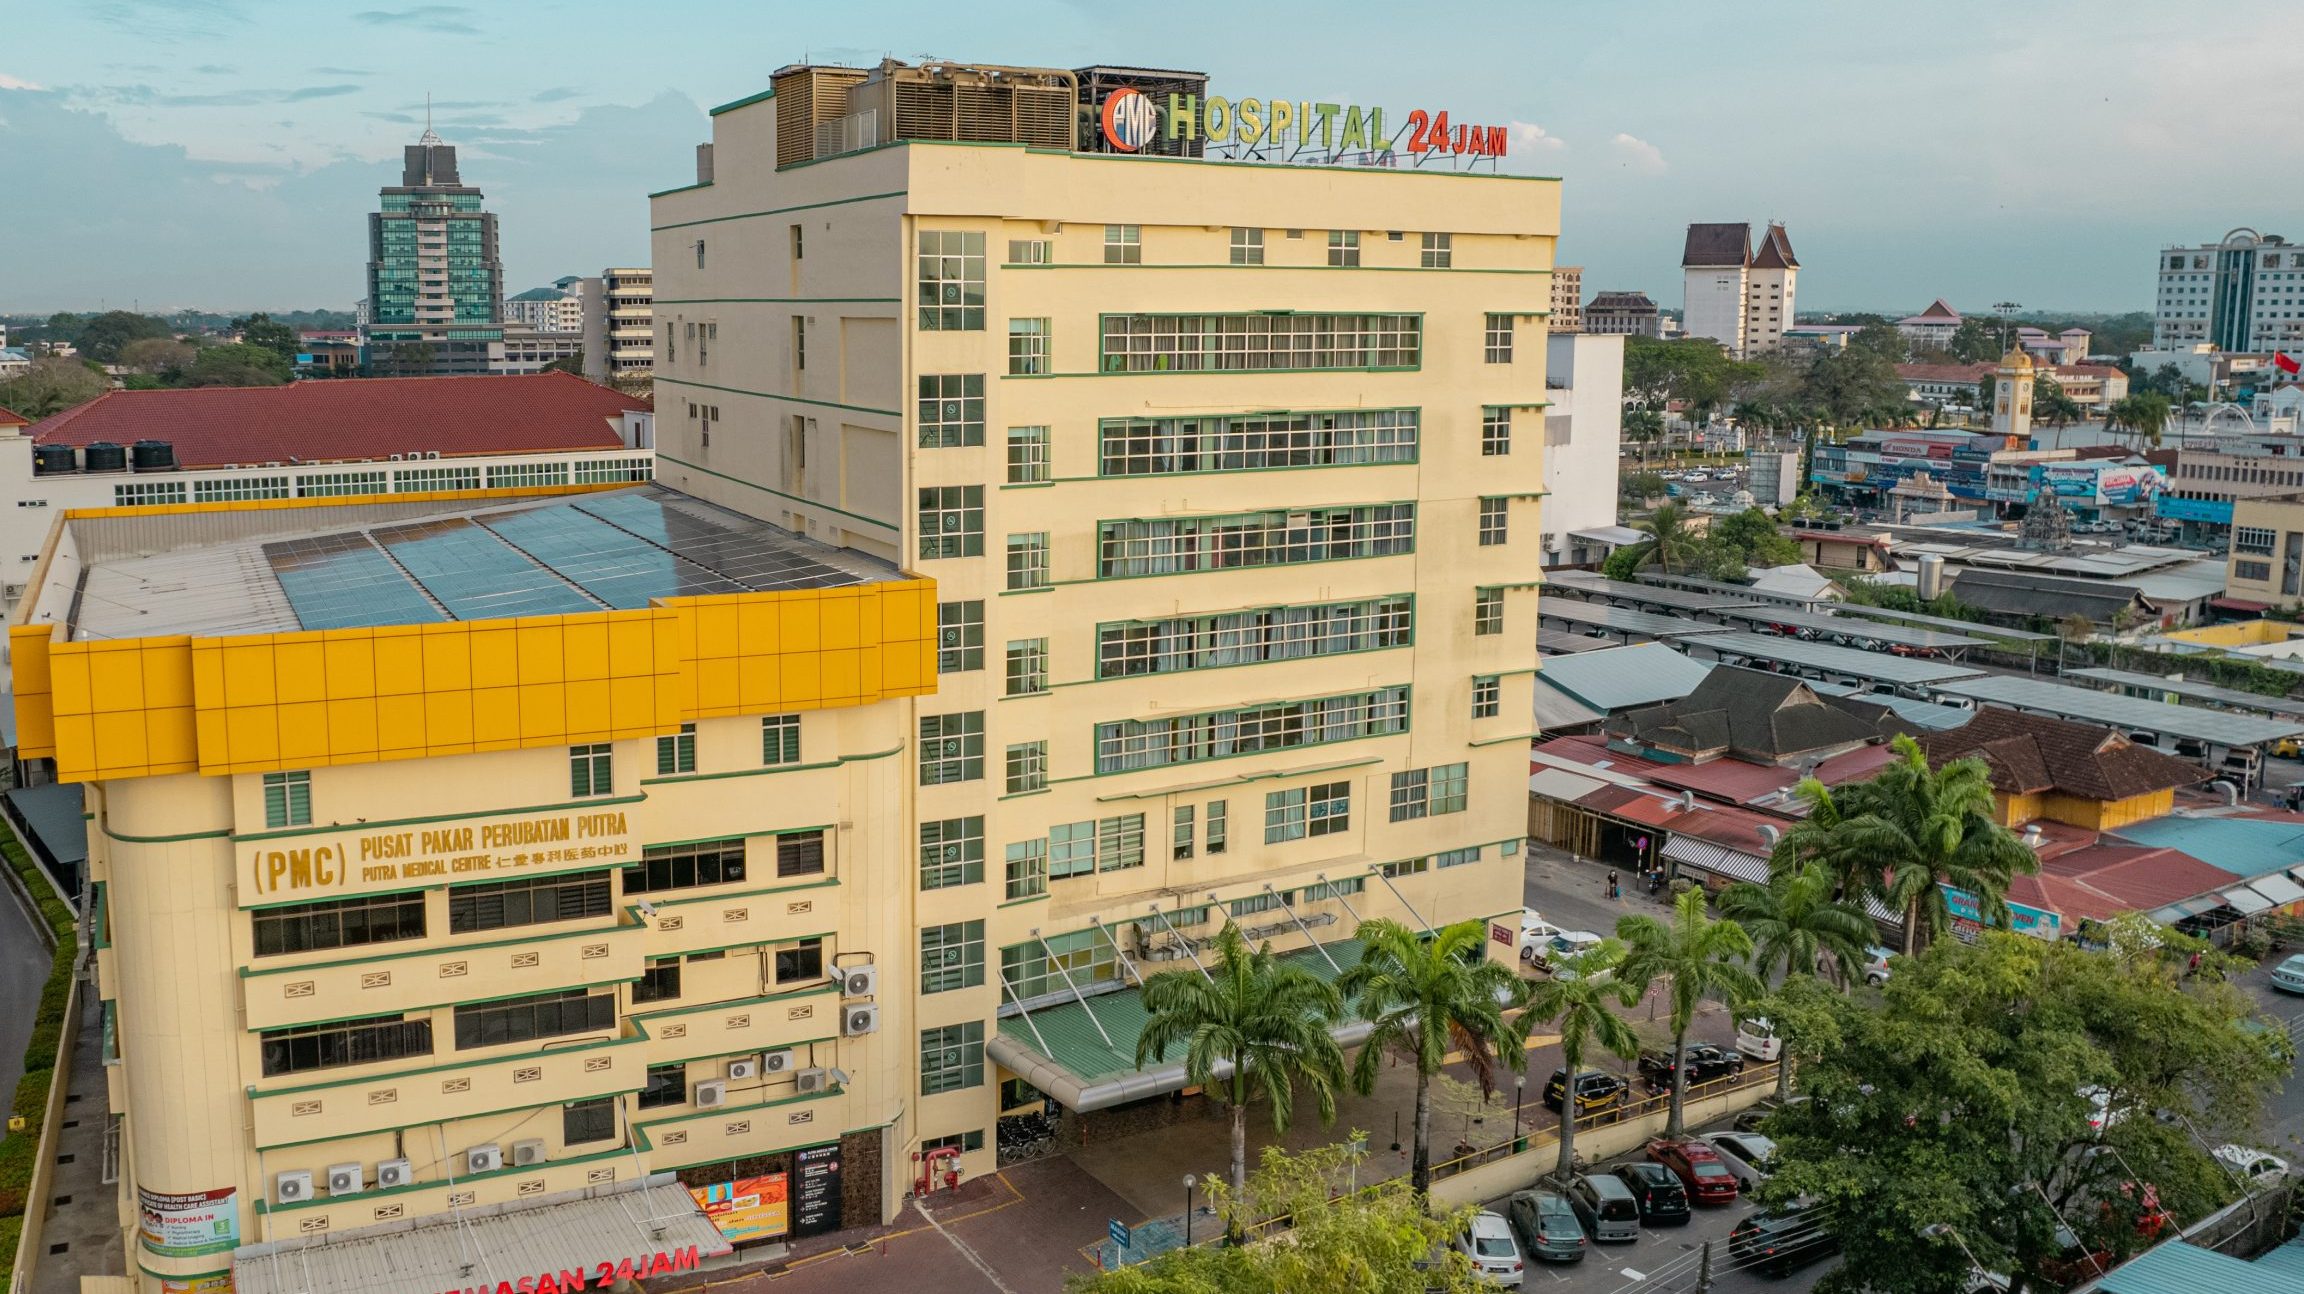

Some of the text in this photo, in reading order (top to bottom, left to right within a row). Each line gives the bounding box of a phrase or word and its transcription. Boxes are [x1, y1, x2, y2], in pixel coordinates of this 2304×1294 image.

[1169, 92, 1392, 150] HOSPITAL
[360, 812, 627, 861] PUSAT PAKAR PERUBATAN PUTRA
[254, 842, 346, 894] (PMC)
[362, 855, 491, 883] PUTRA MEDICAL CENTRE
[164, 1201, 183, 1210] HEALTH
[183, 1201, 199, 1210] CARE
[164, 1213, 214, 1224] DIPLOMA IN
[596, 1245, 701, 1288] 24JAM
